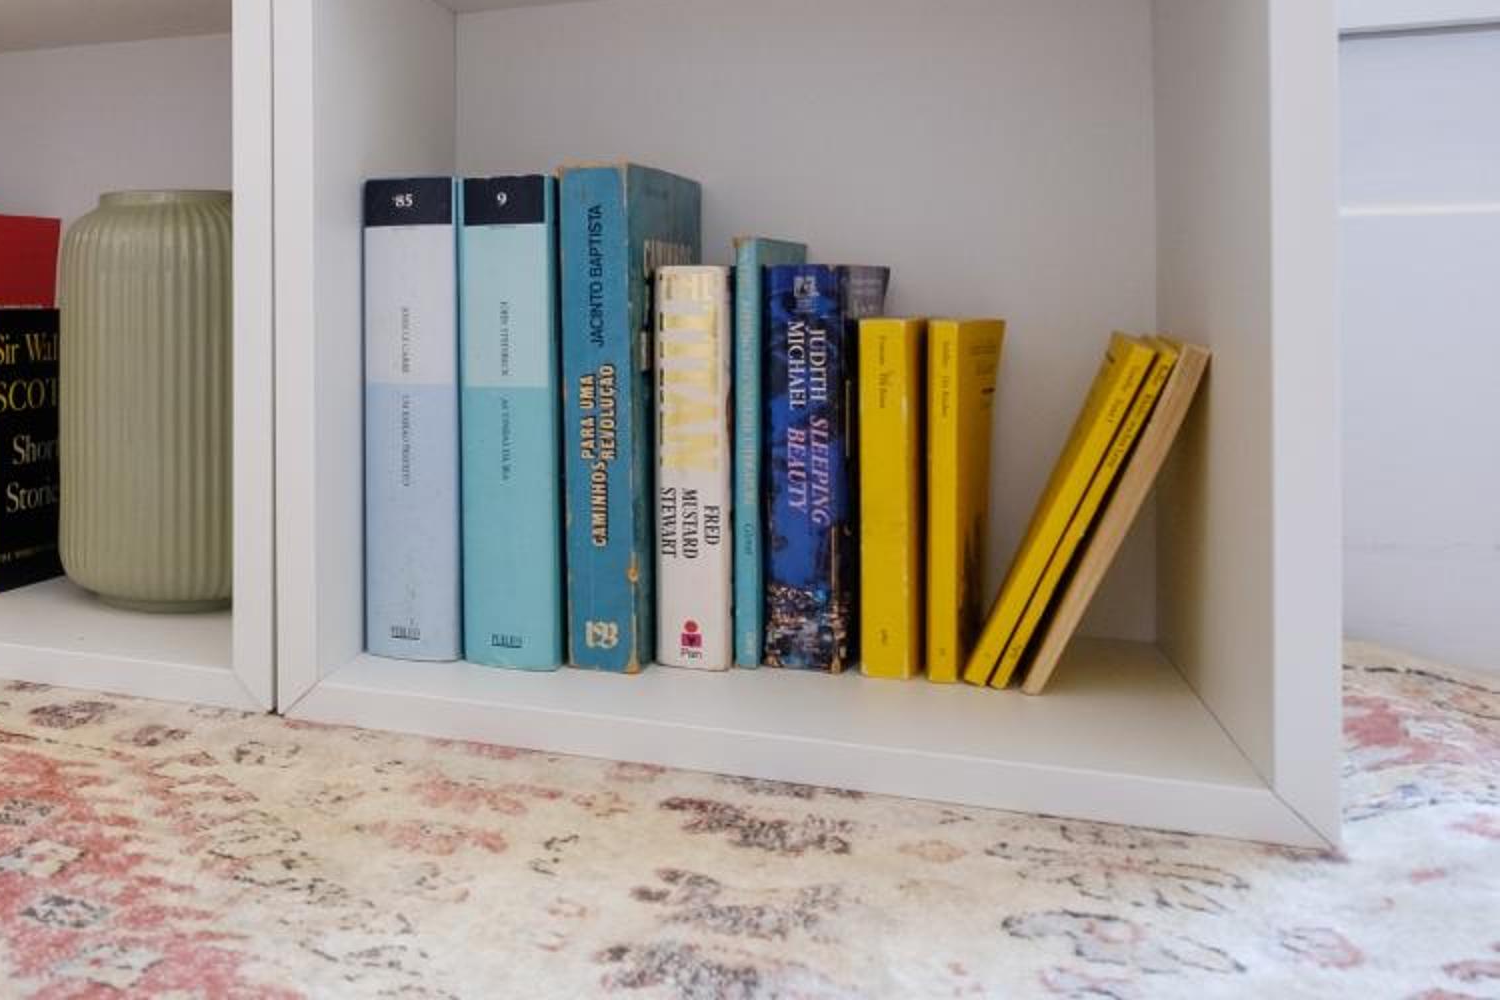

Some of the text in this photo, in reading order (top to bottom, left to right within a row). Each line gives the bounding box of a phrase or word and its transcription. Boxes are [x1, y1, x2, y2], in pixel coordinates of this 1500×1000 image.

[496, 191, 508, 207] 9
[587, 203, 605, 348] JACINTO BAPTISTA
[787, 321, 807, 411] MICHAEL
[806, 327, 827, 401] JUDITH
[579, 375, 597, 460] PARA UMA
[591, 461, 608, 547] CAMINHOS
[787, 427, 807, 514] BEAUTY
[809, 414, 830, 526] SLEEPING
[660, 486, 677, 559] STEWART
[681, 487, 699, 559] MUSTARD
[703, 504, 721, 546] FRED
